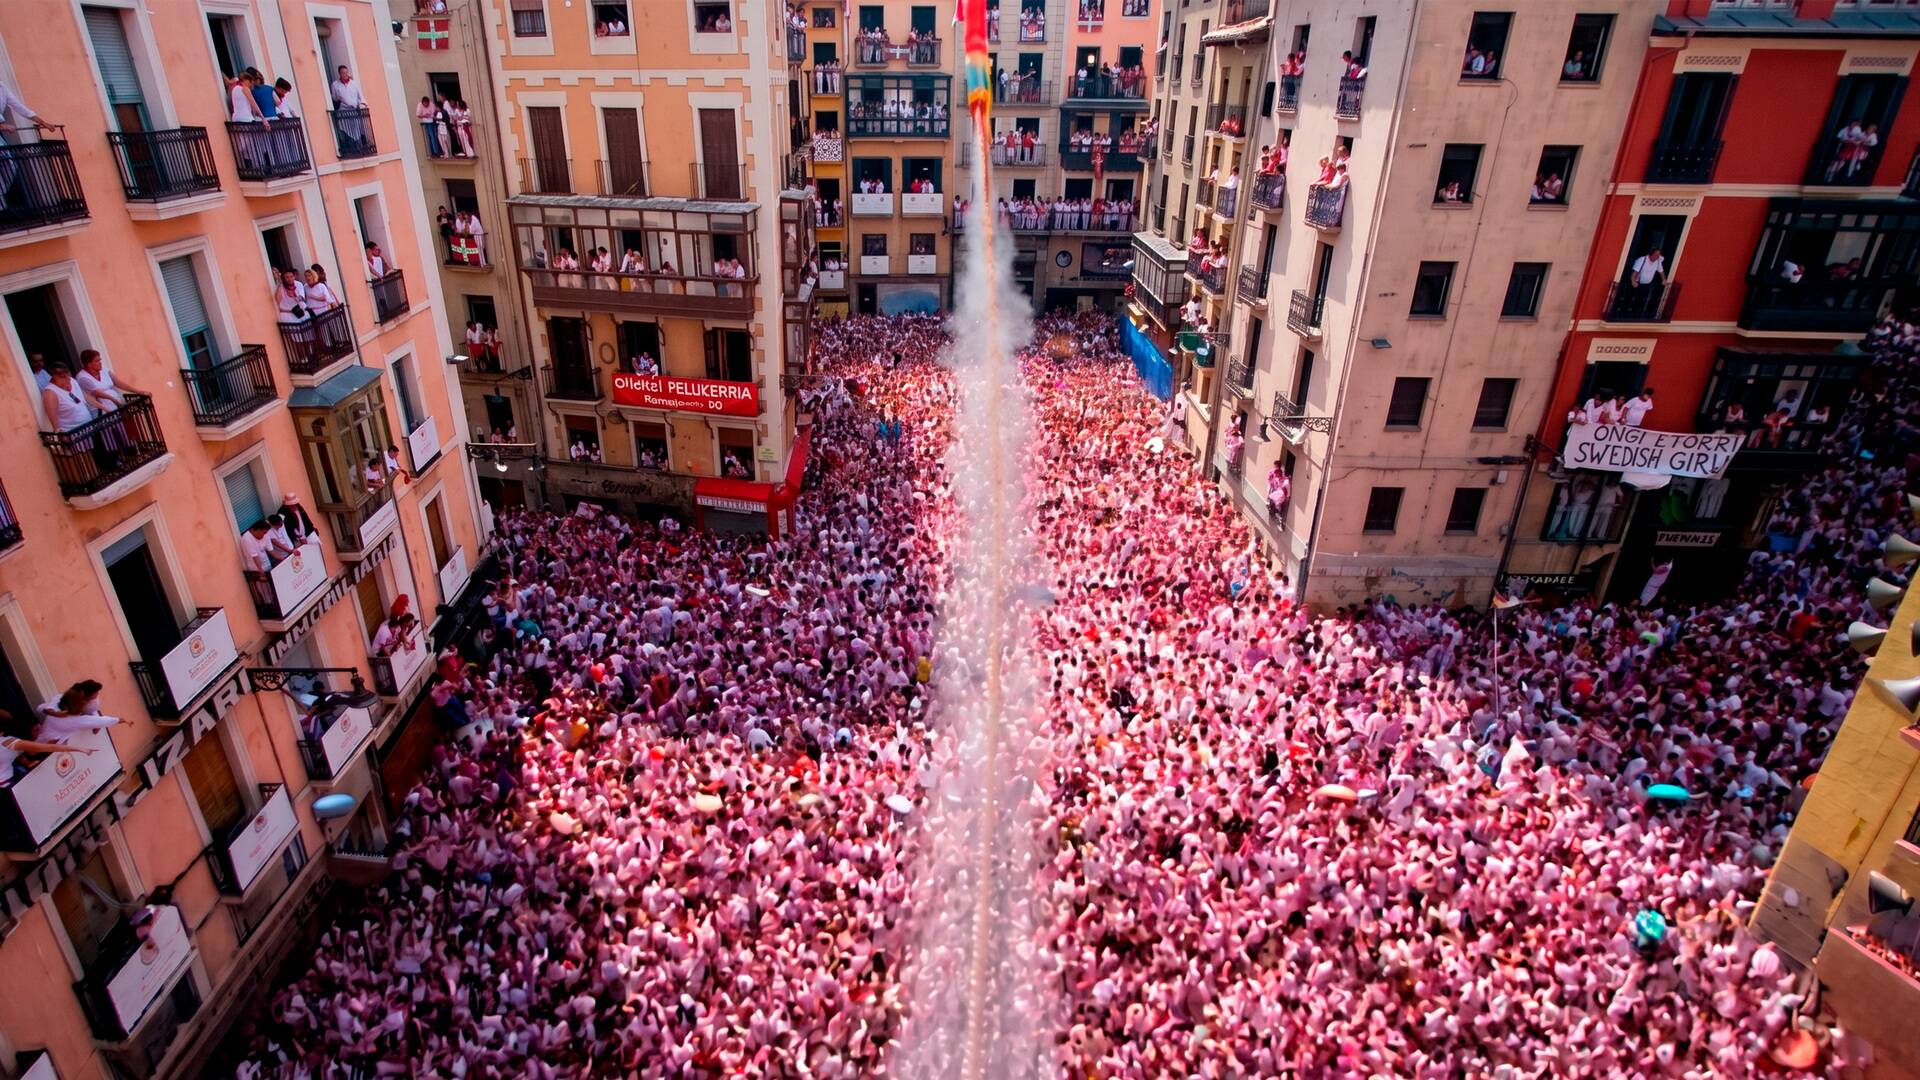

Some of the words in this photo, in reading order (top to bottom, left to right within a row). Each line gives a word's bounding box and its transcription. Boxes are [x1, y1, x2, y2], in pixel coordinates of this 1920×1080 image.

[668, 380, 752, 400] PELUKERRIA
[1594, 425, 1647, 444] ONGI
[1654, 434, 1738, 452] ETORRI
[1574, 442, 1663, 470] SWEDISH
[143, 667, 252, 787] IZARI
